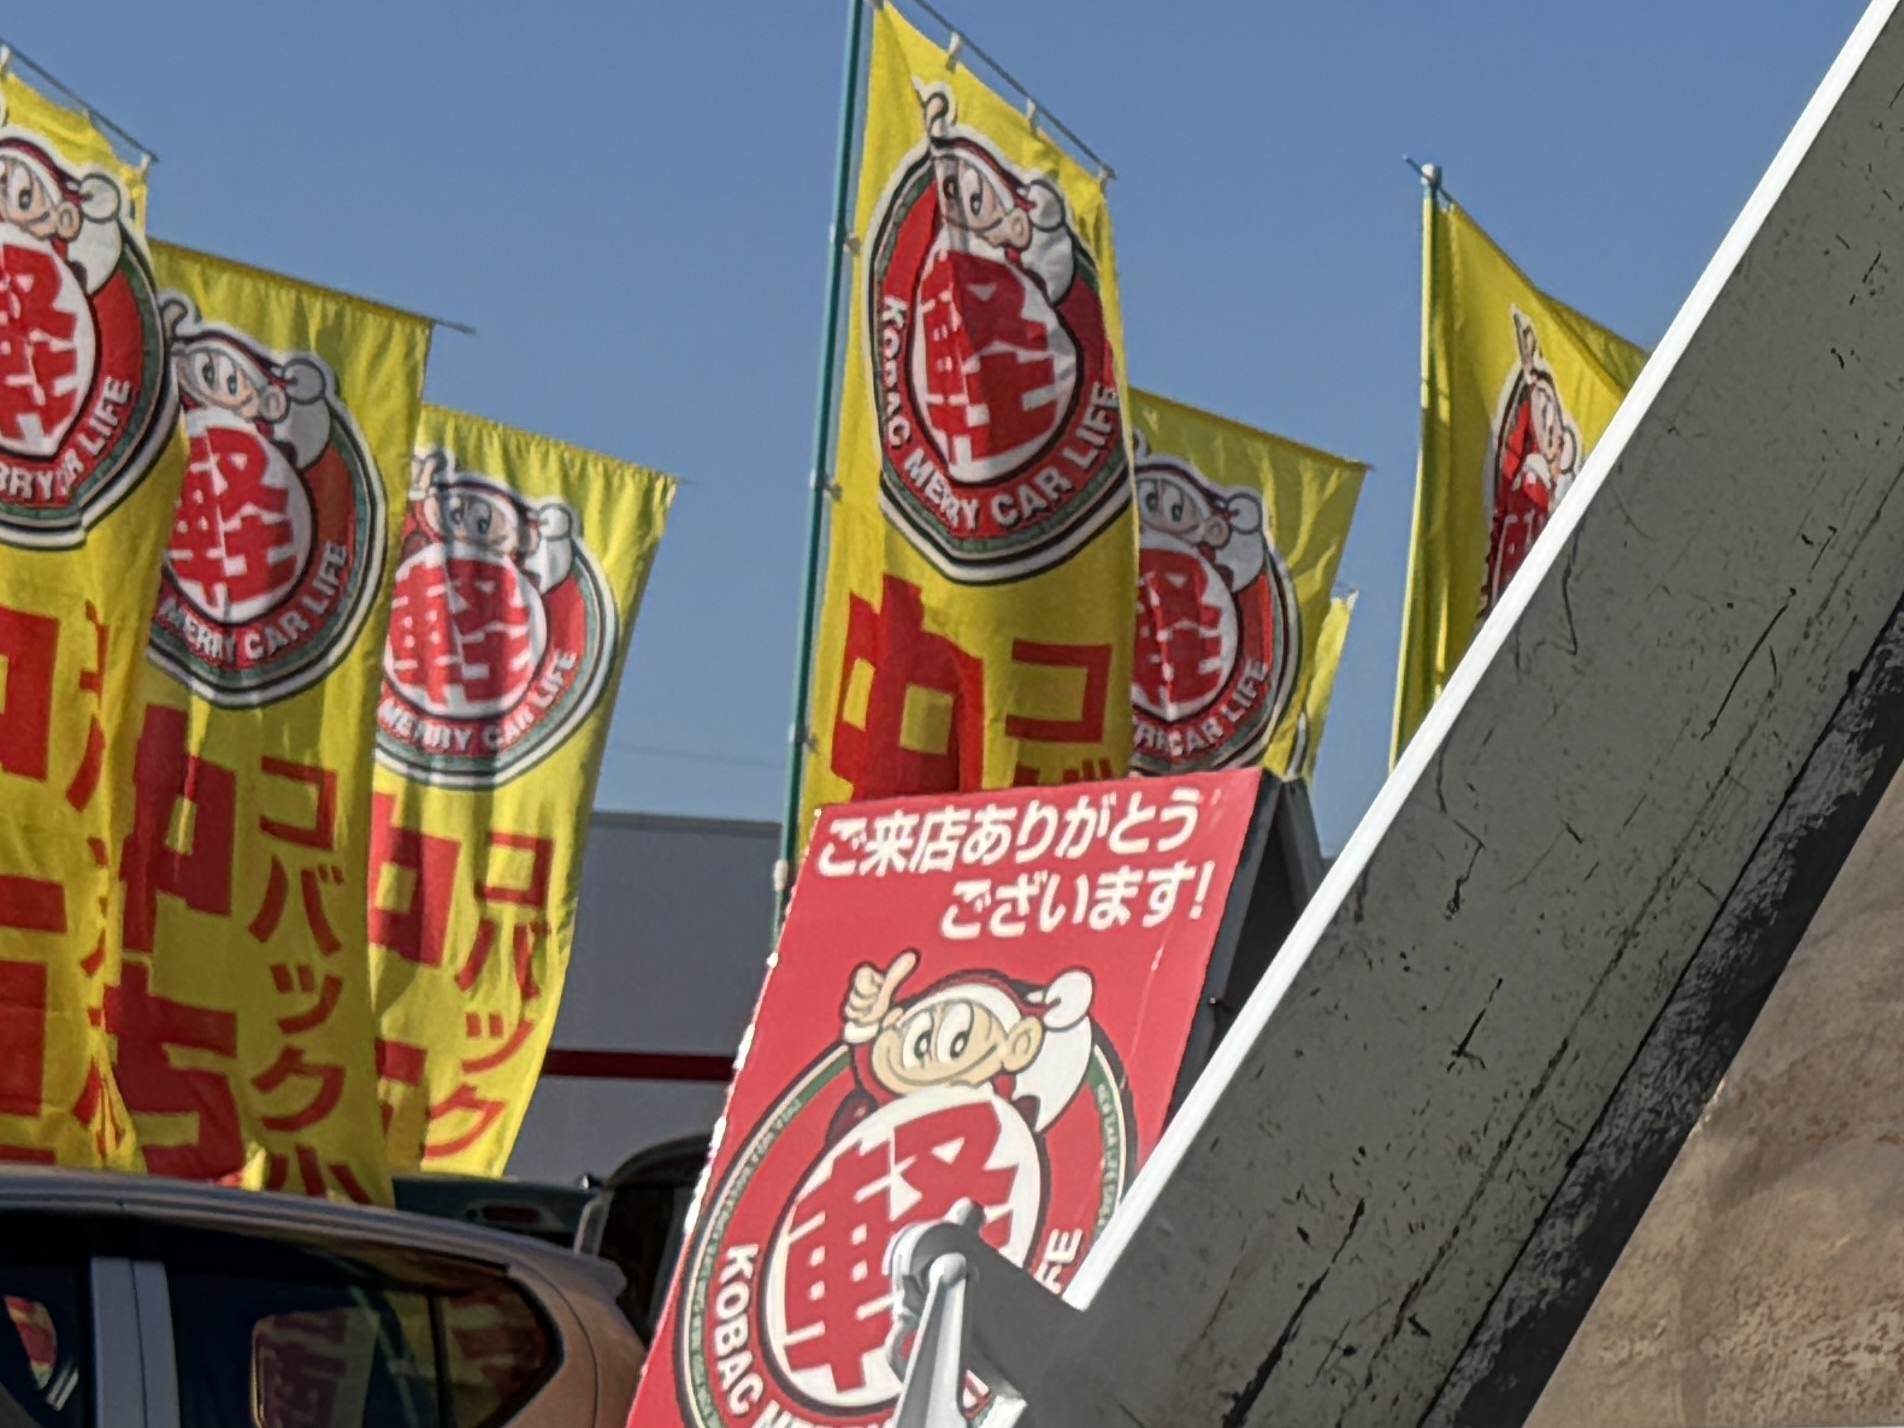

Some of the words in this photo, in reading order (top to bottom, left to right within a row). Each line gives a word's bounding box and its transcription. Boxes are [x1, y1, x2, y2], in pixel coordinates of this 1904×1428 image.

[78, 375, 131, 456] LIFE
[991, 467, 1073, 526] CAR
[1062, 380, 1120, 469] LIFE
[244, 611, 310, 660] CAR
[303, 540, 348, 616] LIFE
[1220, 660, 1270, 722] LIFE
[818, 787, 1200, 877] ご来店ありがとう
[939, 860, 1215, 940] ございます!
[712, 1243, 764, 1417] KOBAC
